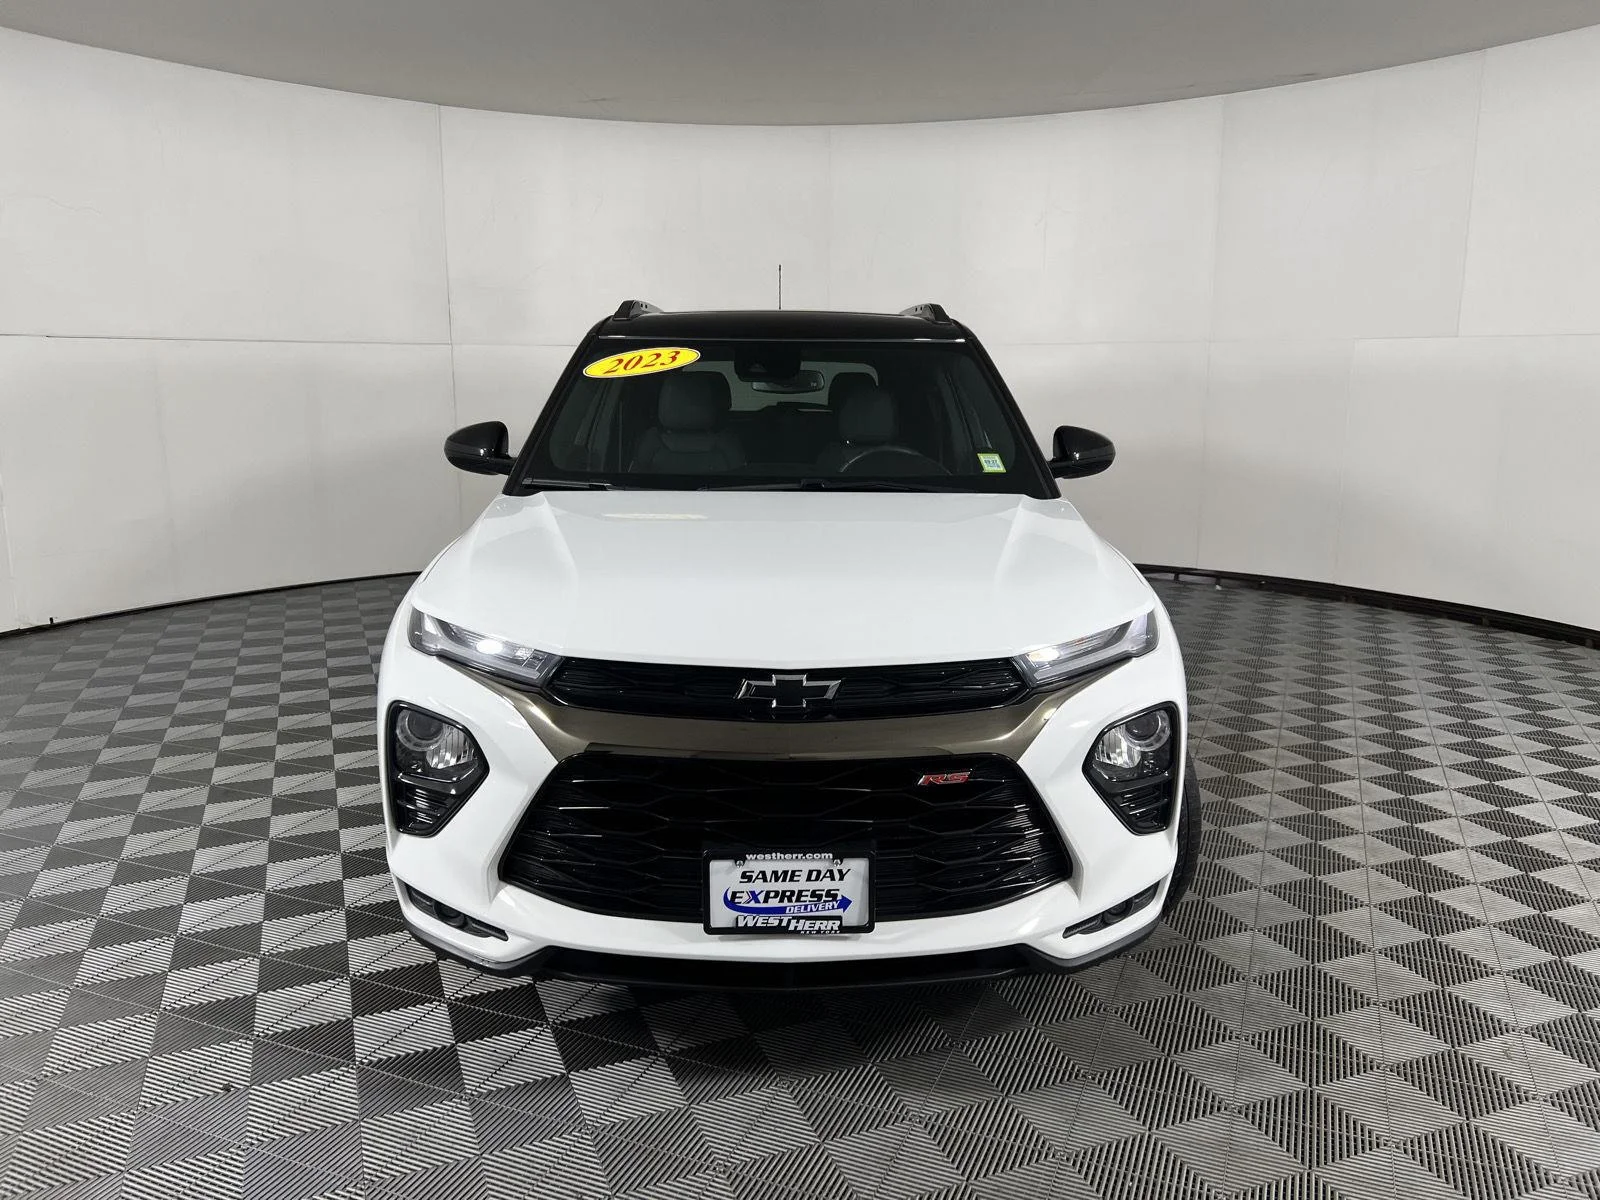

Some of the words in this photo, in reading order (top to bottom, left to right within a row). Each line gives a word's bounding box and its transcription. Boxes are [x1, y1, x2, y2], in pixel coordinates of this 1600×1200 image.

[603, 350, 681, 375] 2023
[917, 771, 971, 786] RS
[746, 852, 833, 860] westherr.com
[739, 869, 803, 884] SAME
[805, 868, 851, 882] DAY
[729, 888, 840, 904] EXPRESS
[785, 900, 840, 914] DELIVERY
